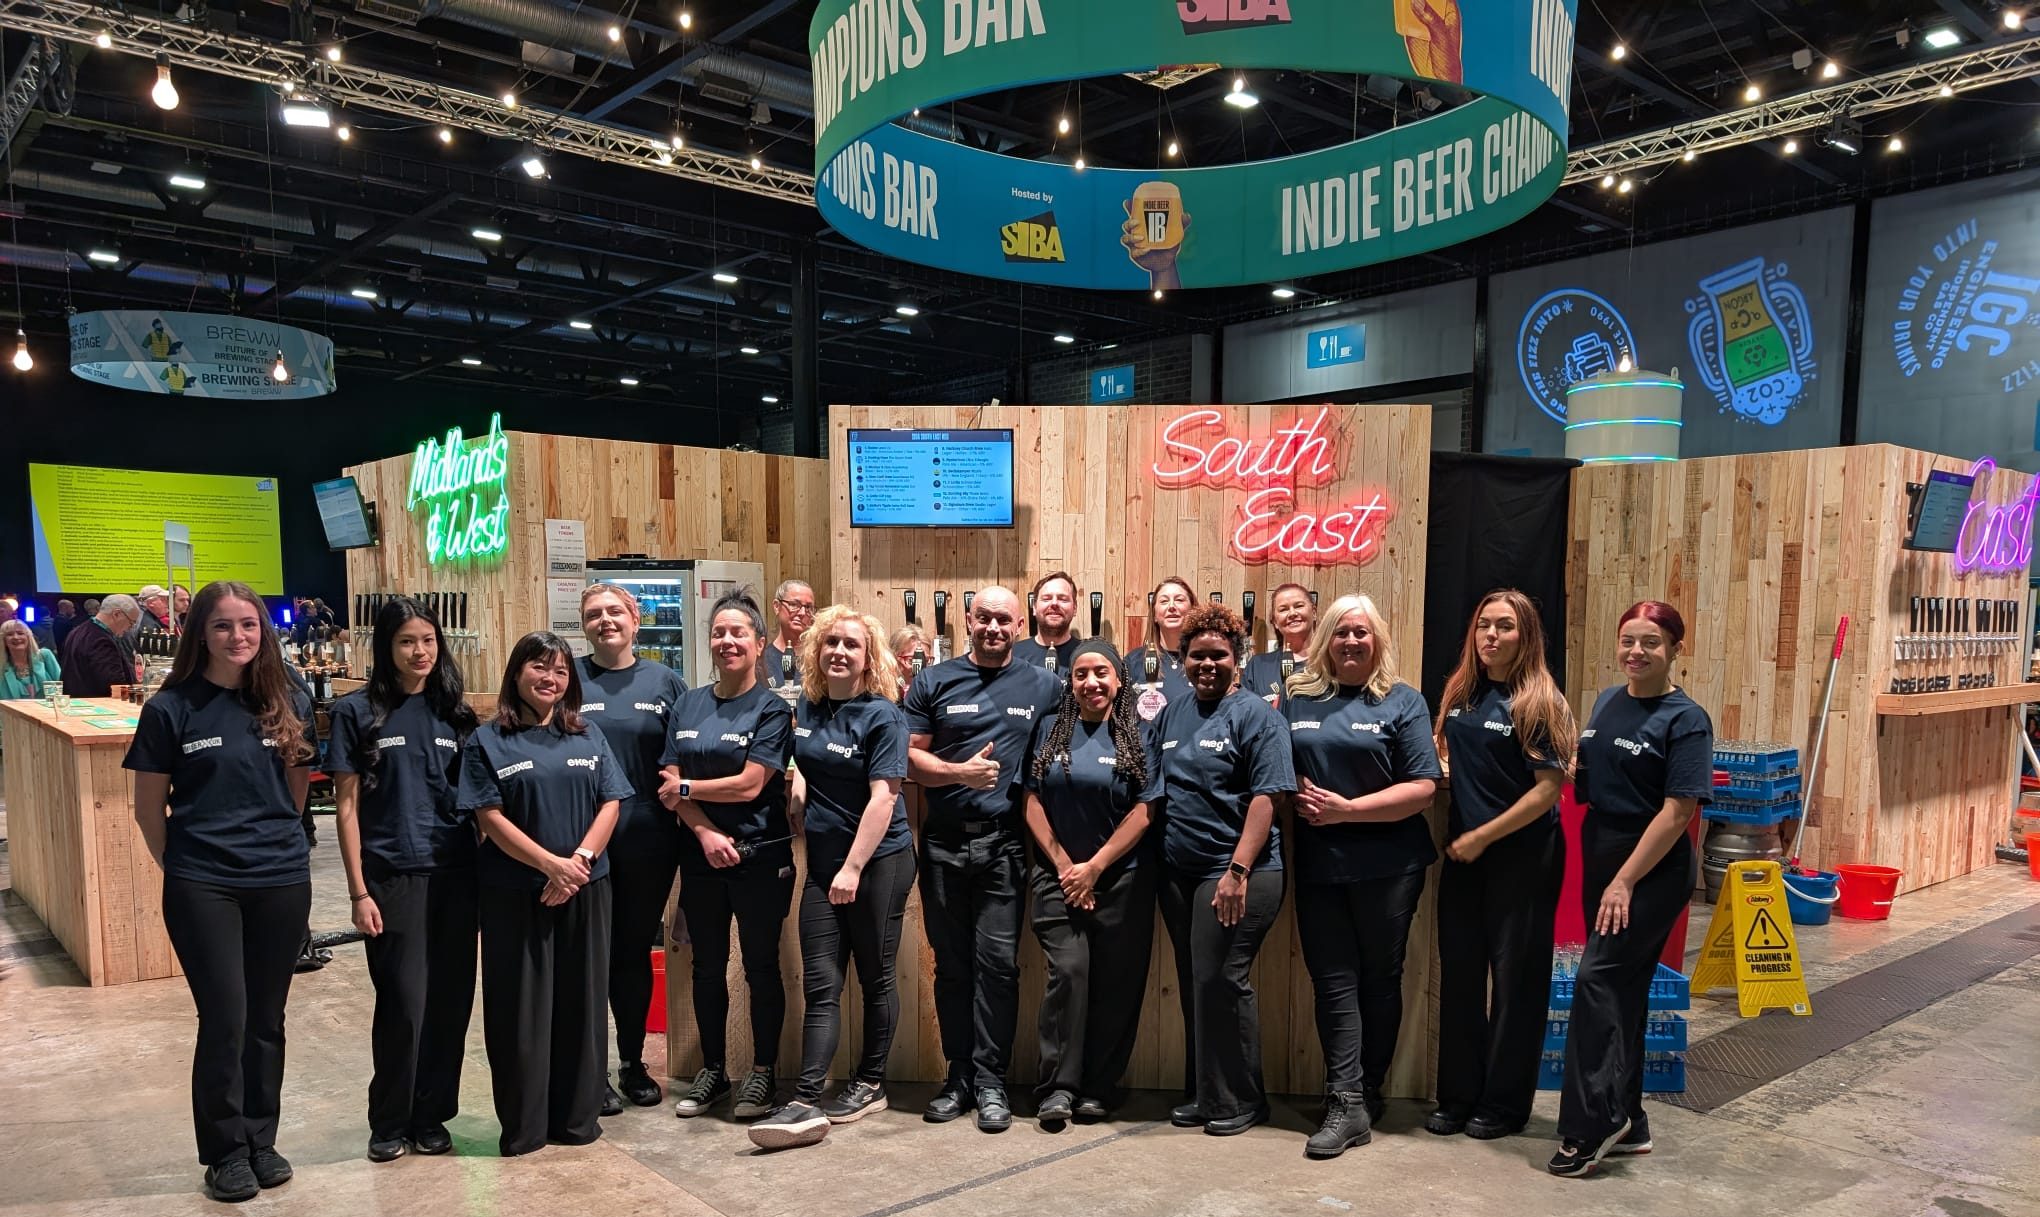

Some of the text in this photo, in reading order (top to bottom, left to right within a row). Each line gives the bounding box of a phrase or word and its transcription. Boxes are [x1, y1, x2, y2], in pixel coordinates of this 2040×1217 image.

[812, 0, 927, 147] AMPIONS
[883, 152, 939, 240] BAR
[1011, 187, 1054, 204] Hosted by
[1282, 111, 1559, 256] INDIE BEER CHAM
[1001, 221, 1065, 262] SIBA
[1148, 212, 1166, 242] IB
[1933, 218, 1979, 262] INTO
[1898, 265, 1934, 311] YOUR
[1533, 304, 1561, 335] INTO
[1590, 306, 1615, 331] 1990
[1925, 281, 1951, 331] GAS CO
[1926, 259, 1971, 351] INDEPENDENT
[1931, 240, 1999, 369] ENGINEERING
[1956, 270, 2040, 357] IGC
[206, 325, 281, 348] BREWW
[225, 345, 269, 357] FUTURE OF
[1894, 320, 1922, 377] DRINKS
[214, 352, 277, 366] BREWING STAG
[1528, 336, 1539, 368] FIZZ
[202, 373, 260, 386] BREWING
[1532, 372, 1550, 399] THE
[1747, 379, 1785, 403] CO2
[1153, 407, 1330, 477] South
[407, 412, 509, 511] Midlands
[446, 493, 509, 560] West
[1234, 487, 1387, 553] East
[1957, 457, 2040, 567] East
[634, 702, 663, 714] ekeg
[1007, 707, 1032, 719] ekeg
[721, 733, 748, 746] ekeg
[1484, 720, 1513, 737] ekeg
[827, 742, 853, 758] ekeg
[1098, 757, 1118, 765] eke
[1614, 737, 1643, 756] ekeg
[567, 758, 596, 770] ekeg
[1745, 952, 1792, 963] CLEANING IN
[1751, 963, 1791, 973] PROGRESS
